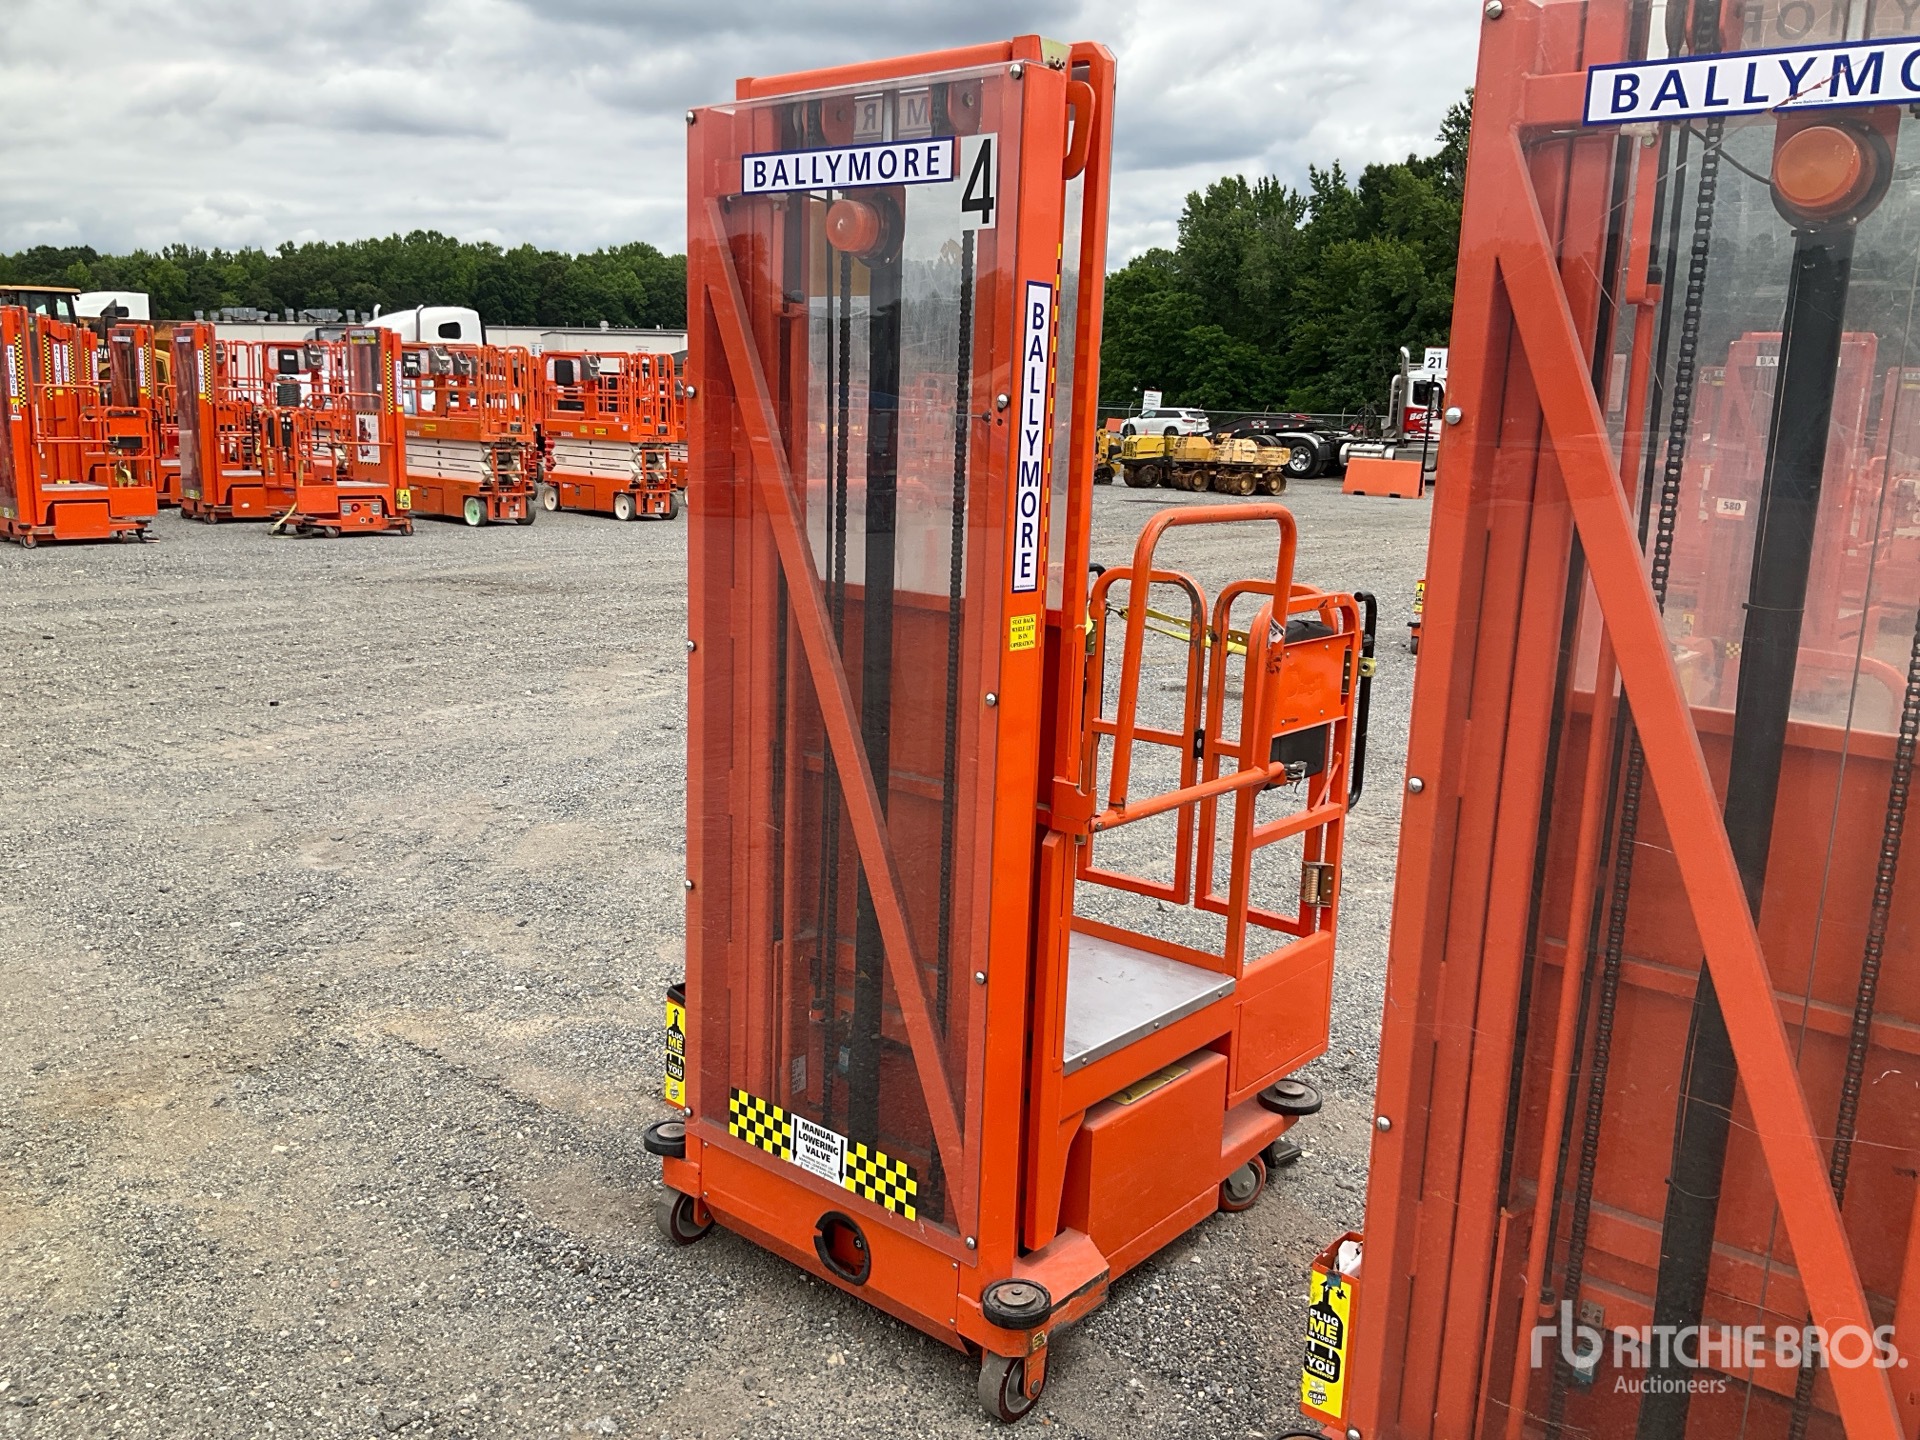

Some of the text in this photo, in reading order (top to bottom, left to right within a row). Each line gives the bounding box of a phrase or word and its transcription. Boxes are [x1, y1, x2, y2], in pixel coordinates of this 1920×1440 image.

[754, 145, 940, 188] BALLYMORE
[961, 138, 994, 224] 4
[1427, 357, 1442, 369] 21
[1020, 302, 1045, 578] BALLYMORE
[1723, 501, 1741, 511] 580
[1010, 640, 1034, 648] OPERATION
[668, 1029, 684, 1041] PLUG
[668, 1036, 683, 1051] ME
[668, 1063, 683, 1077] YOU
[802, 1122, 836, 1144] MANUAL
[798, 1130, 839, 1156] LOWERING
[805, 1144, 831, 1163] VALVE
[1309, 1308, 1339, 1327] PLUG
[1309, 1317, 1338, 1340] ME
[1316, 1333, 1337, 1346] TODAY
[1313, 1353, 1327, 1362] WORK
[1306, 1365, 1334, 1380] TOMORROW
[1307, 1356, 1336, 1376] YOU
[1308, 1392, 1327, 1401] GEAR
